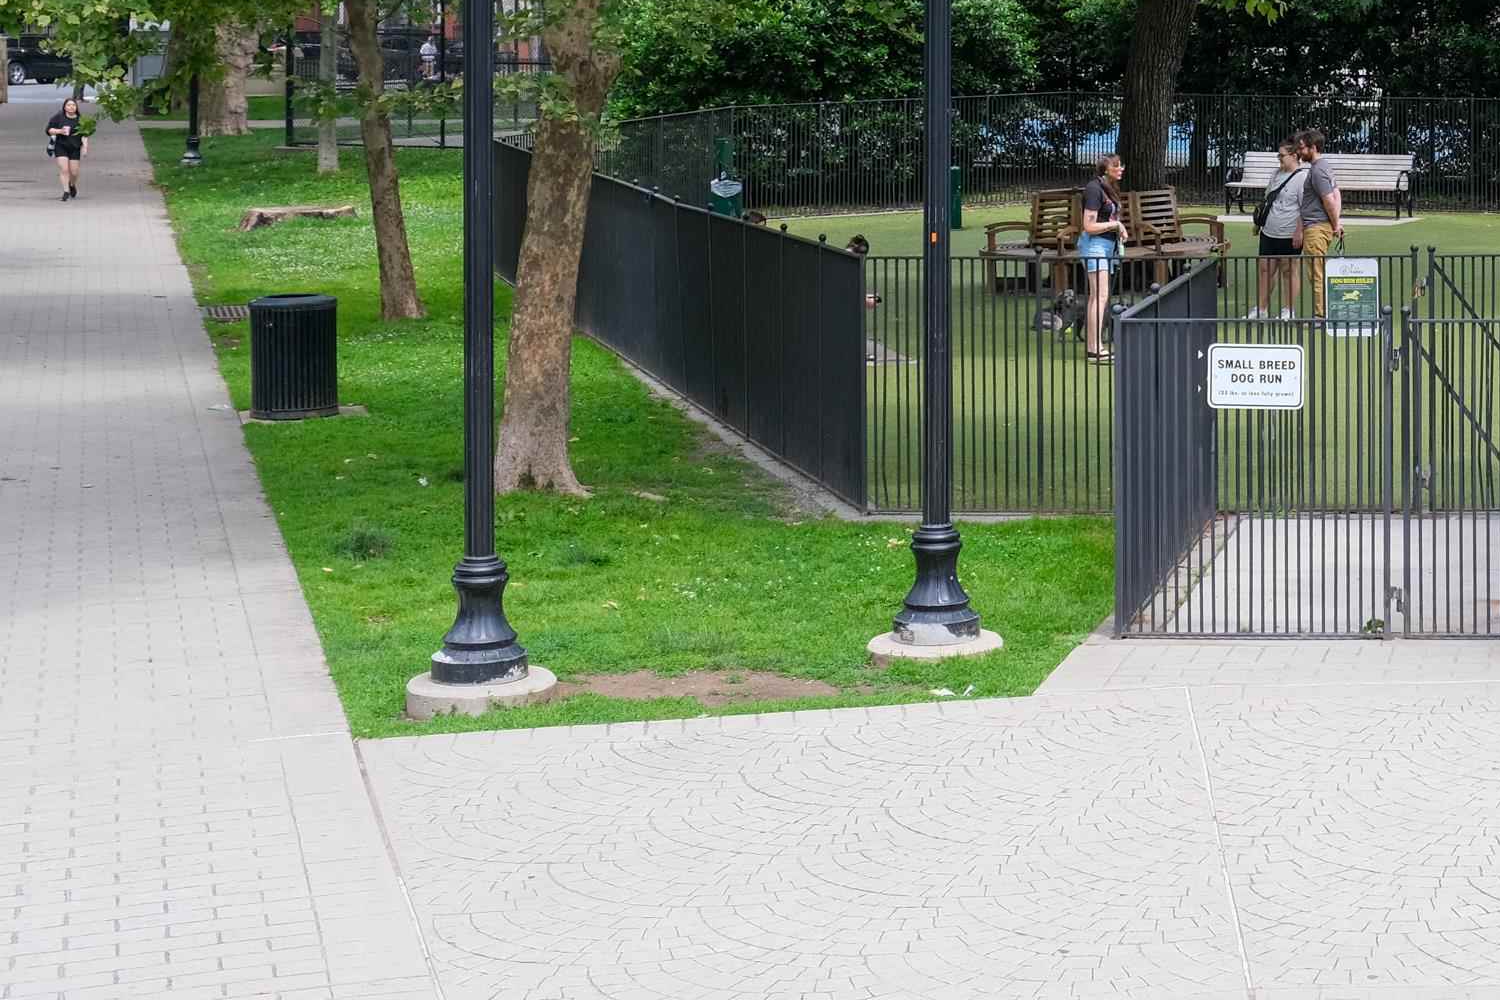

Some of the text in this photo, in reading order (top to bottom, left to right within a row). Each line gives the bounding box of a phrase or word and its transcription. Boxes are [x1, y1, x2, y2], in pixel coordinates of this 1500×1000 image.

[1217, 360, 1296, 370] SMALL BREED
[1231, 373, 1282, 384] DOG RUN
